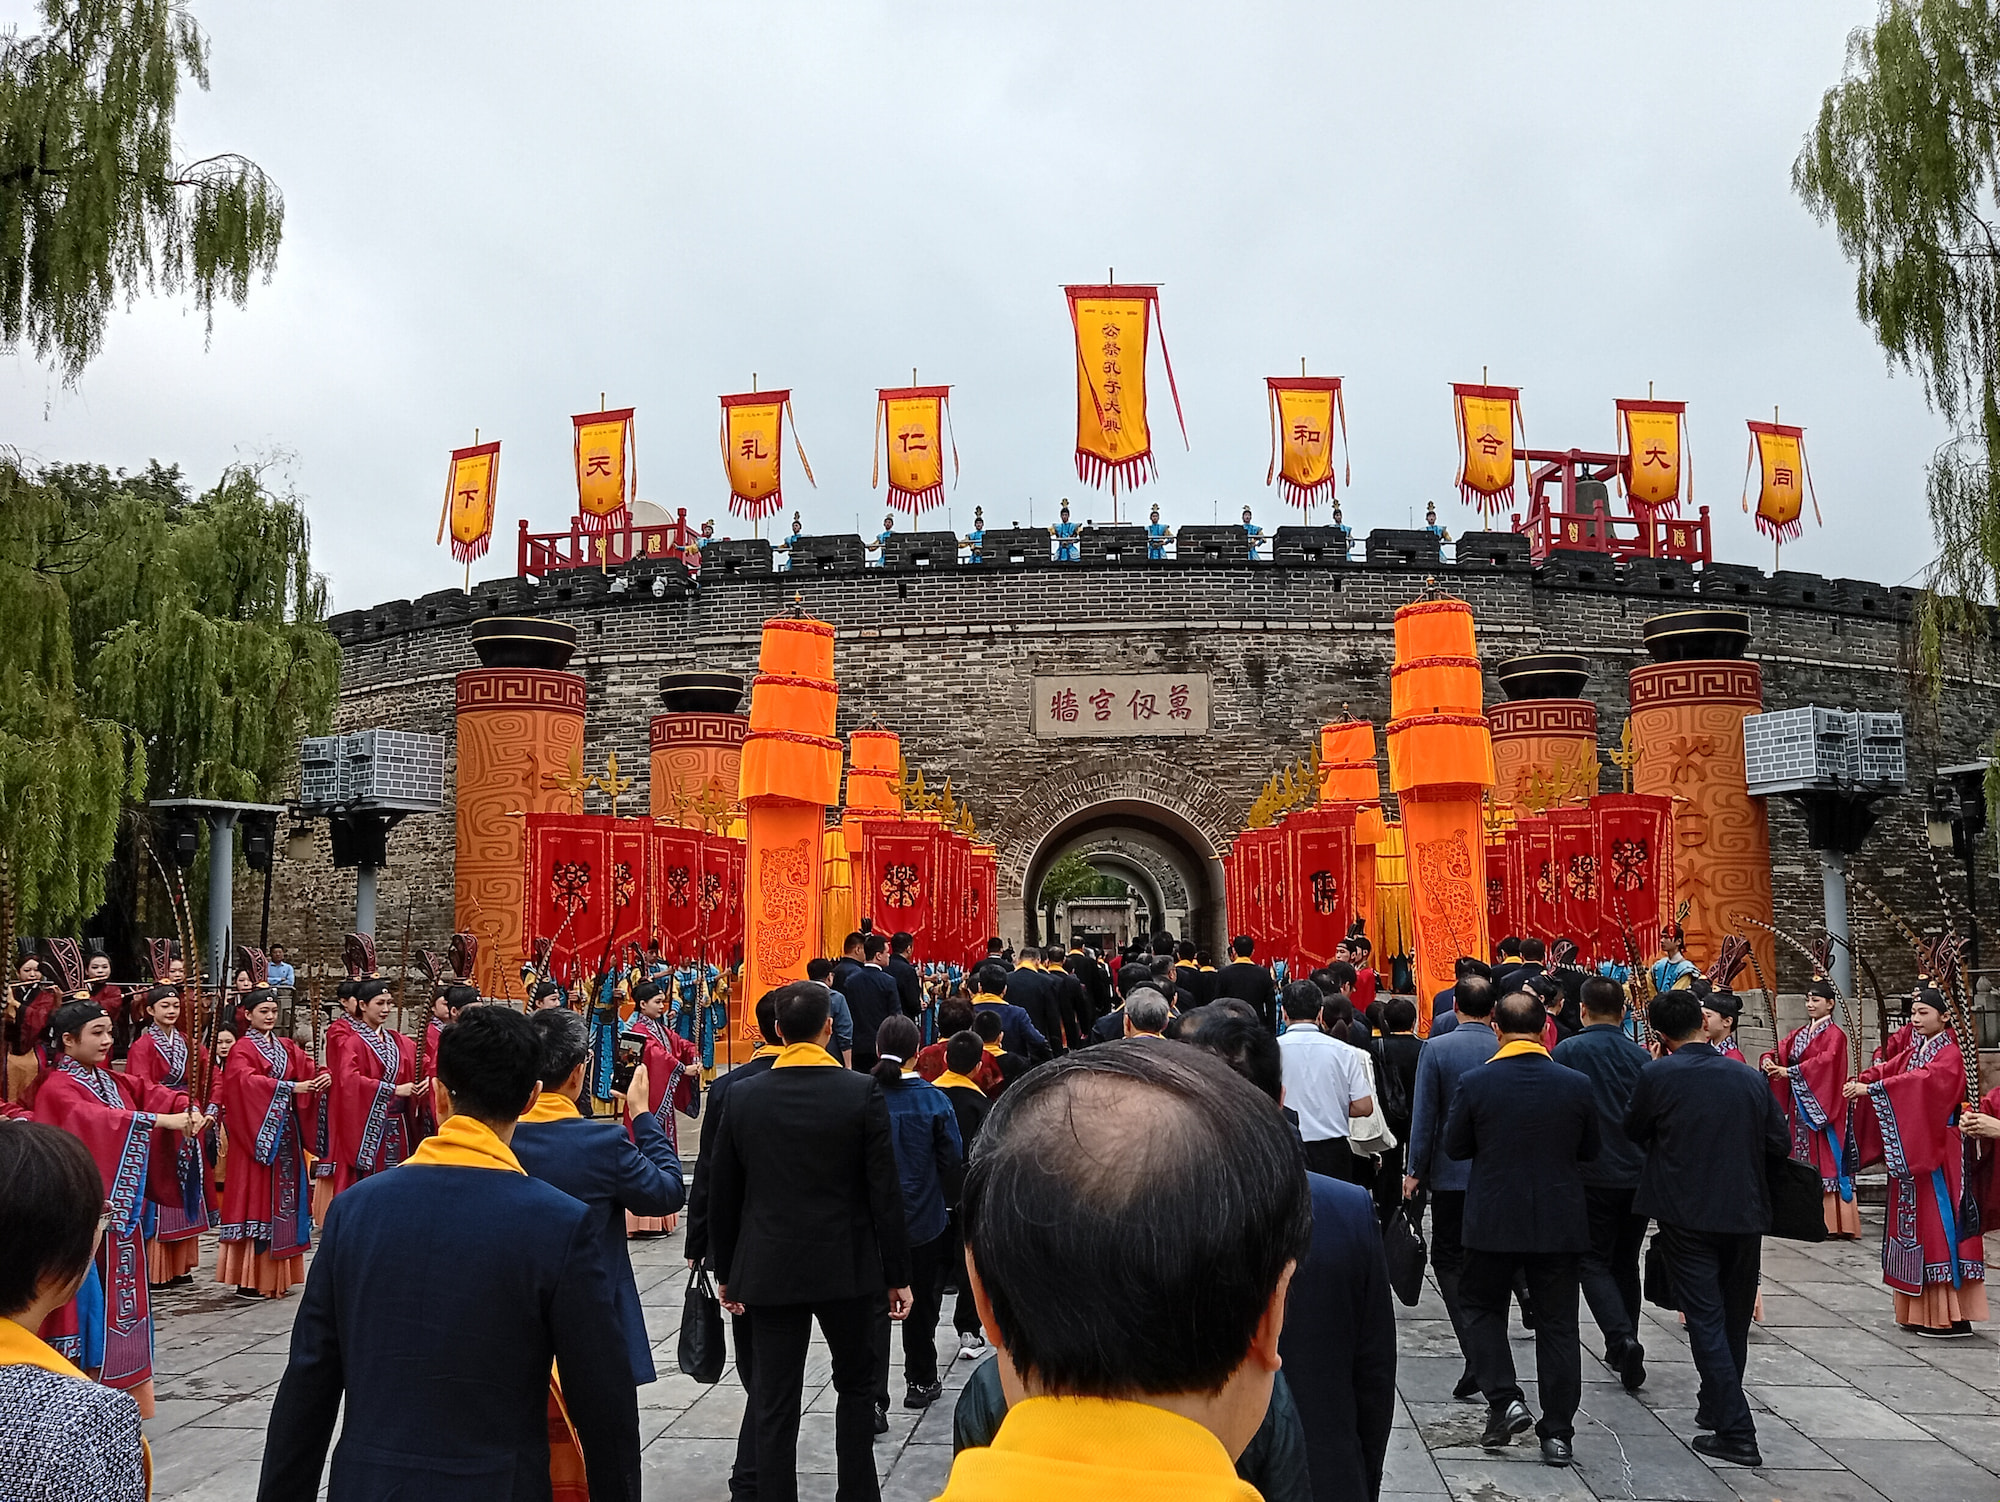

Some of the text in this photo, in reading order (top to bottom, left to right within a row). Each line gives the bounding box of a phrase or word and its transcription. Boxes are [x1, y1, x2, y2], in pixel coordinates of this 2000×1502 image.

[1102, 323, 1122, 433] 公祭孔子大典
[898, 433, 927, 452] 仁
[1293, 425, 1320, 445] 和
[1476, 433, 1504, 455] 合
[741, 439, 768, 460] 礼
[1642, 446, 1671, 469] 大
[586, 456, 612, 476] 天
[1773, 468, 1794, 490] 同
[458, 488, 480, 509] 下
